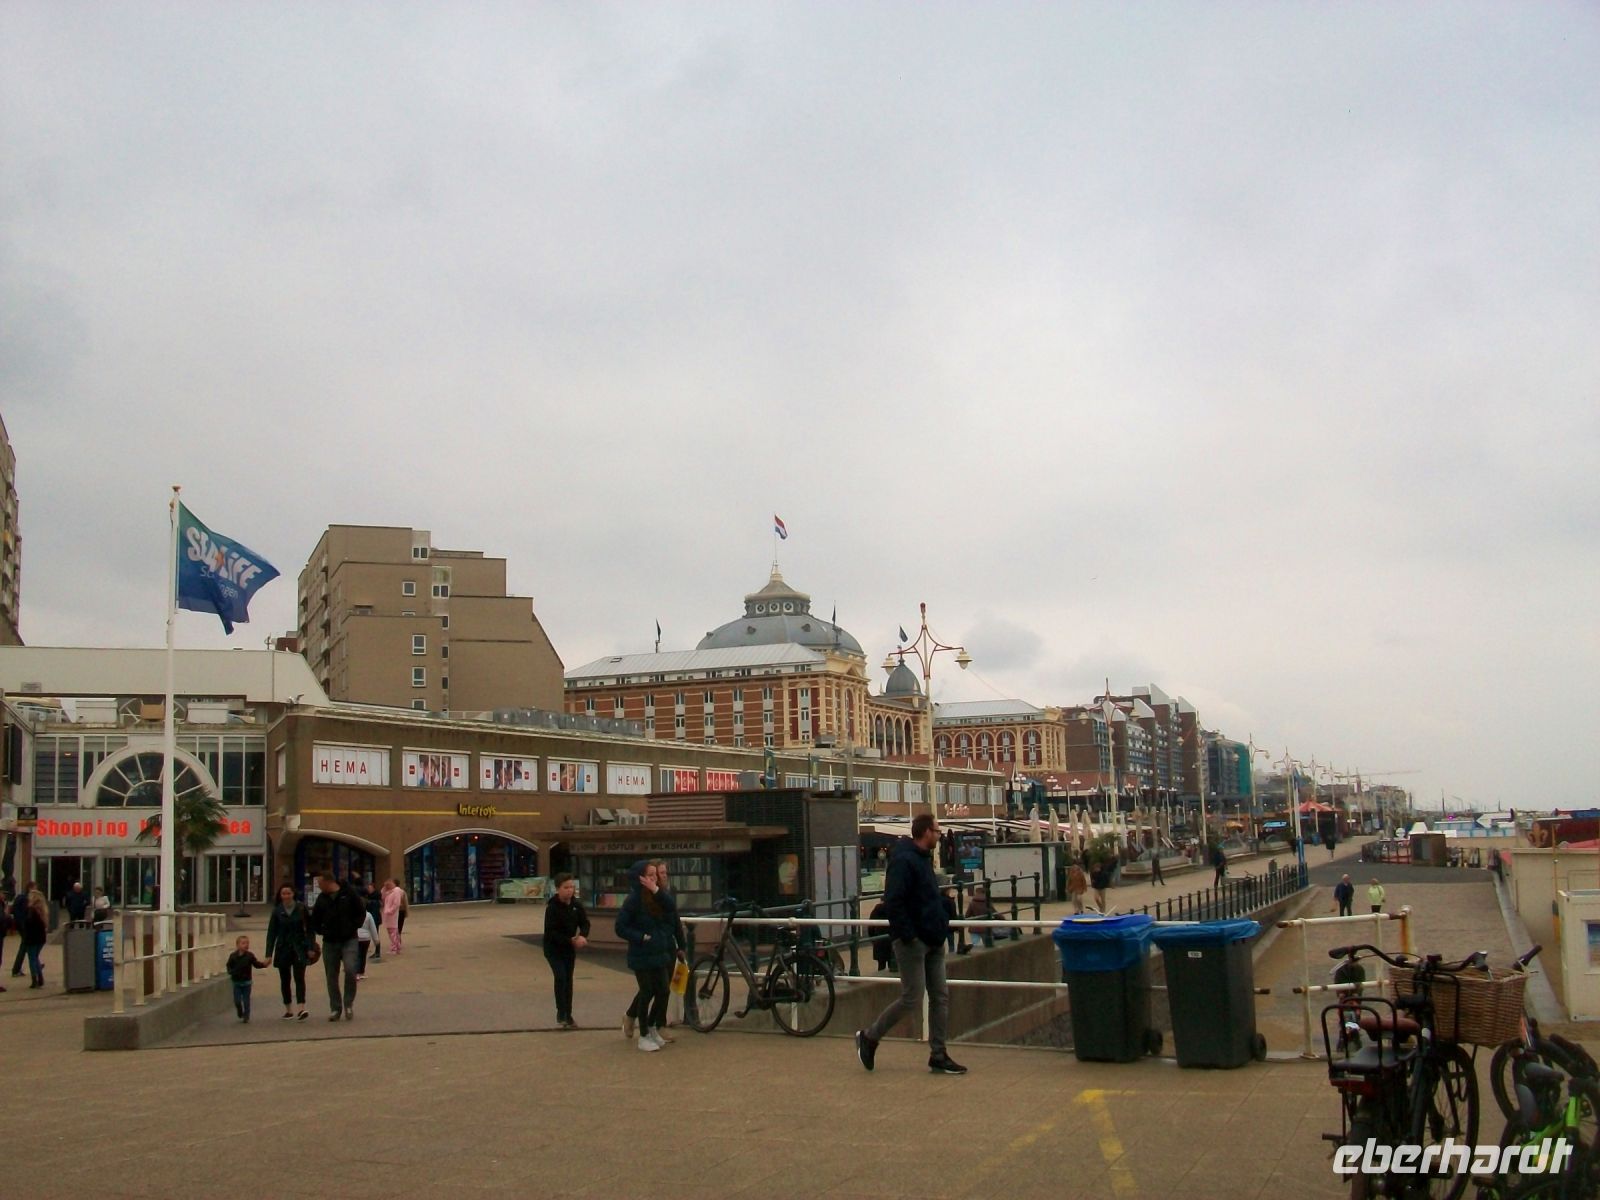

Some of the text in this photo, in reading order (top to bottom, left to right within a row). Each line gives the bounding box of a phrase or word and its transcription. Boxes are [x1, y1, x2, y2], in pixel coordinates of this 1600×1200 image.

[320, 759, 367, 774] HEMA
[617, 775, 646, 786] HEMA
[458, 802, 497, 818] Intertoys
[37, 819, 128, 838] Shopping
[650, 841, 701, 851] MILKSHAKE
